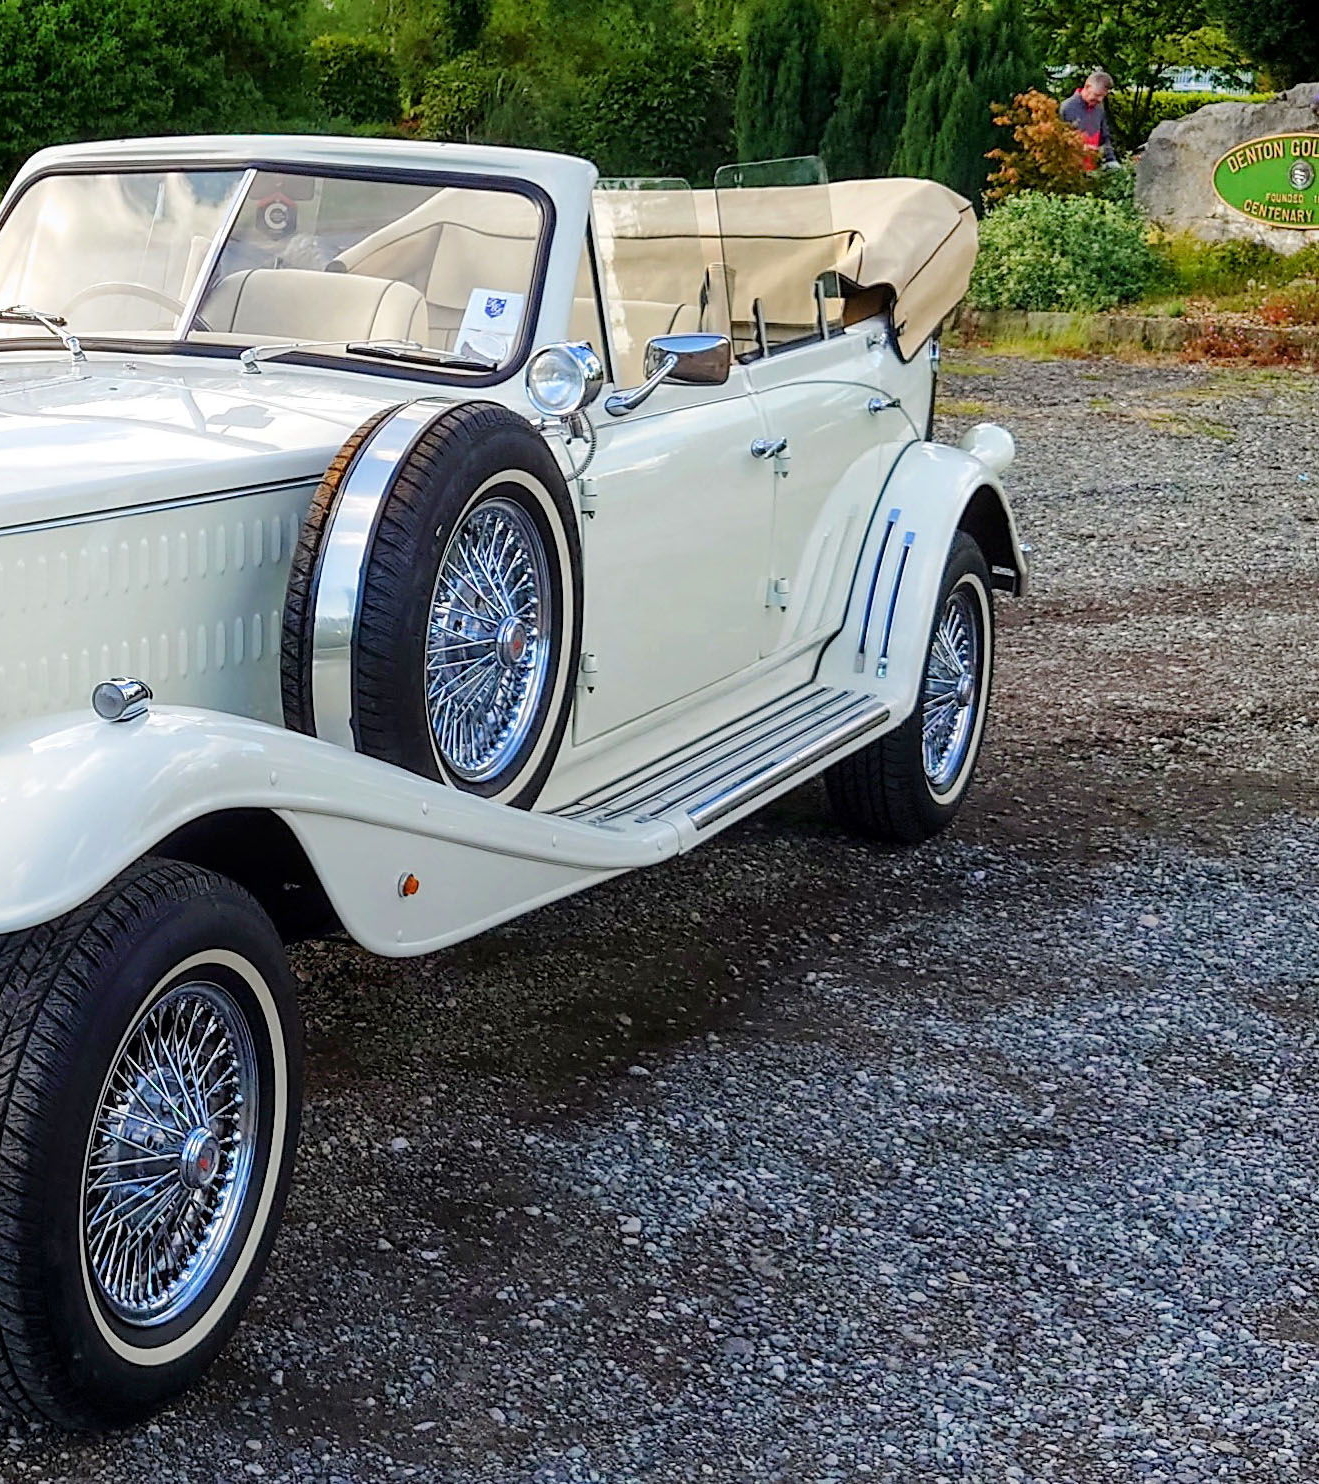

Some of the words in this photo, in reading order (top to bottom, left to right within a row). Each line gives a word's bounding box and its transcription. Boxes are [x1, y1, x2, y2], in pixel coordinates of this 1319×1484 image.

[1227, 141, 1284, 173] DENTON
[1265, 192, 1304, 204] FOUNDED
[1243, 199, 1313, 222] CENTENARY
